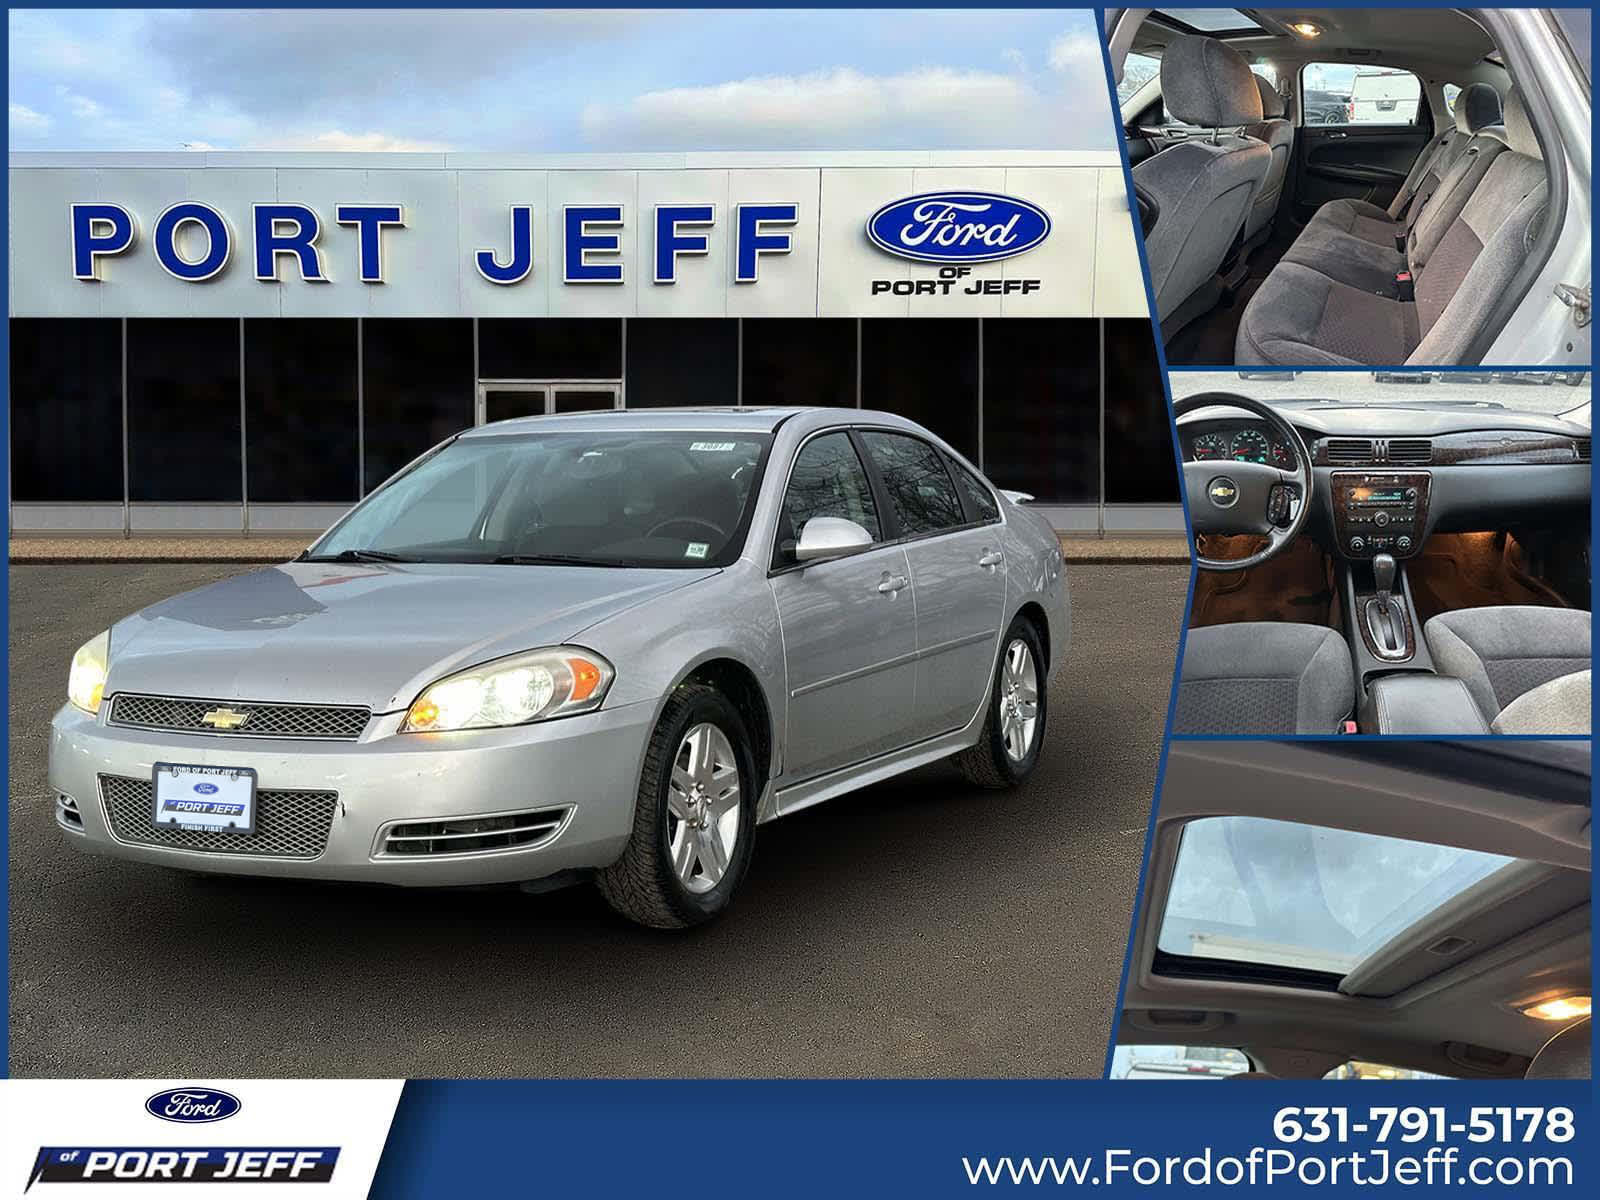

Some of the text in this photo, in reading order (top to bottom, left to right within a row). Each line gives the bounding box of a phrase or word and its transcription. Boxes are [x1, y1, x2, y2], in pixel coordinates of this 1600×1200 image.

[899, 200, 1022, 247] Ford
[71, 203, 798, 284] PORT JEFF
[938, 266, 972, 279] OF
[871, 280, 1041, 296] PORT JEFF
[176, 802, 209, 812] PORT
[210, 803, 241, 814] JEFF
